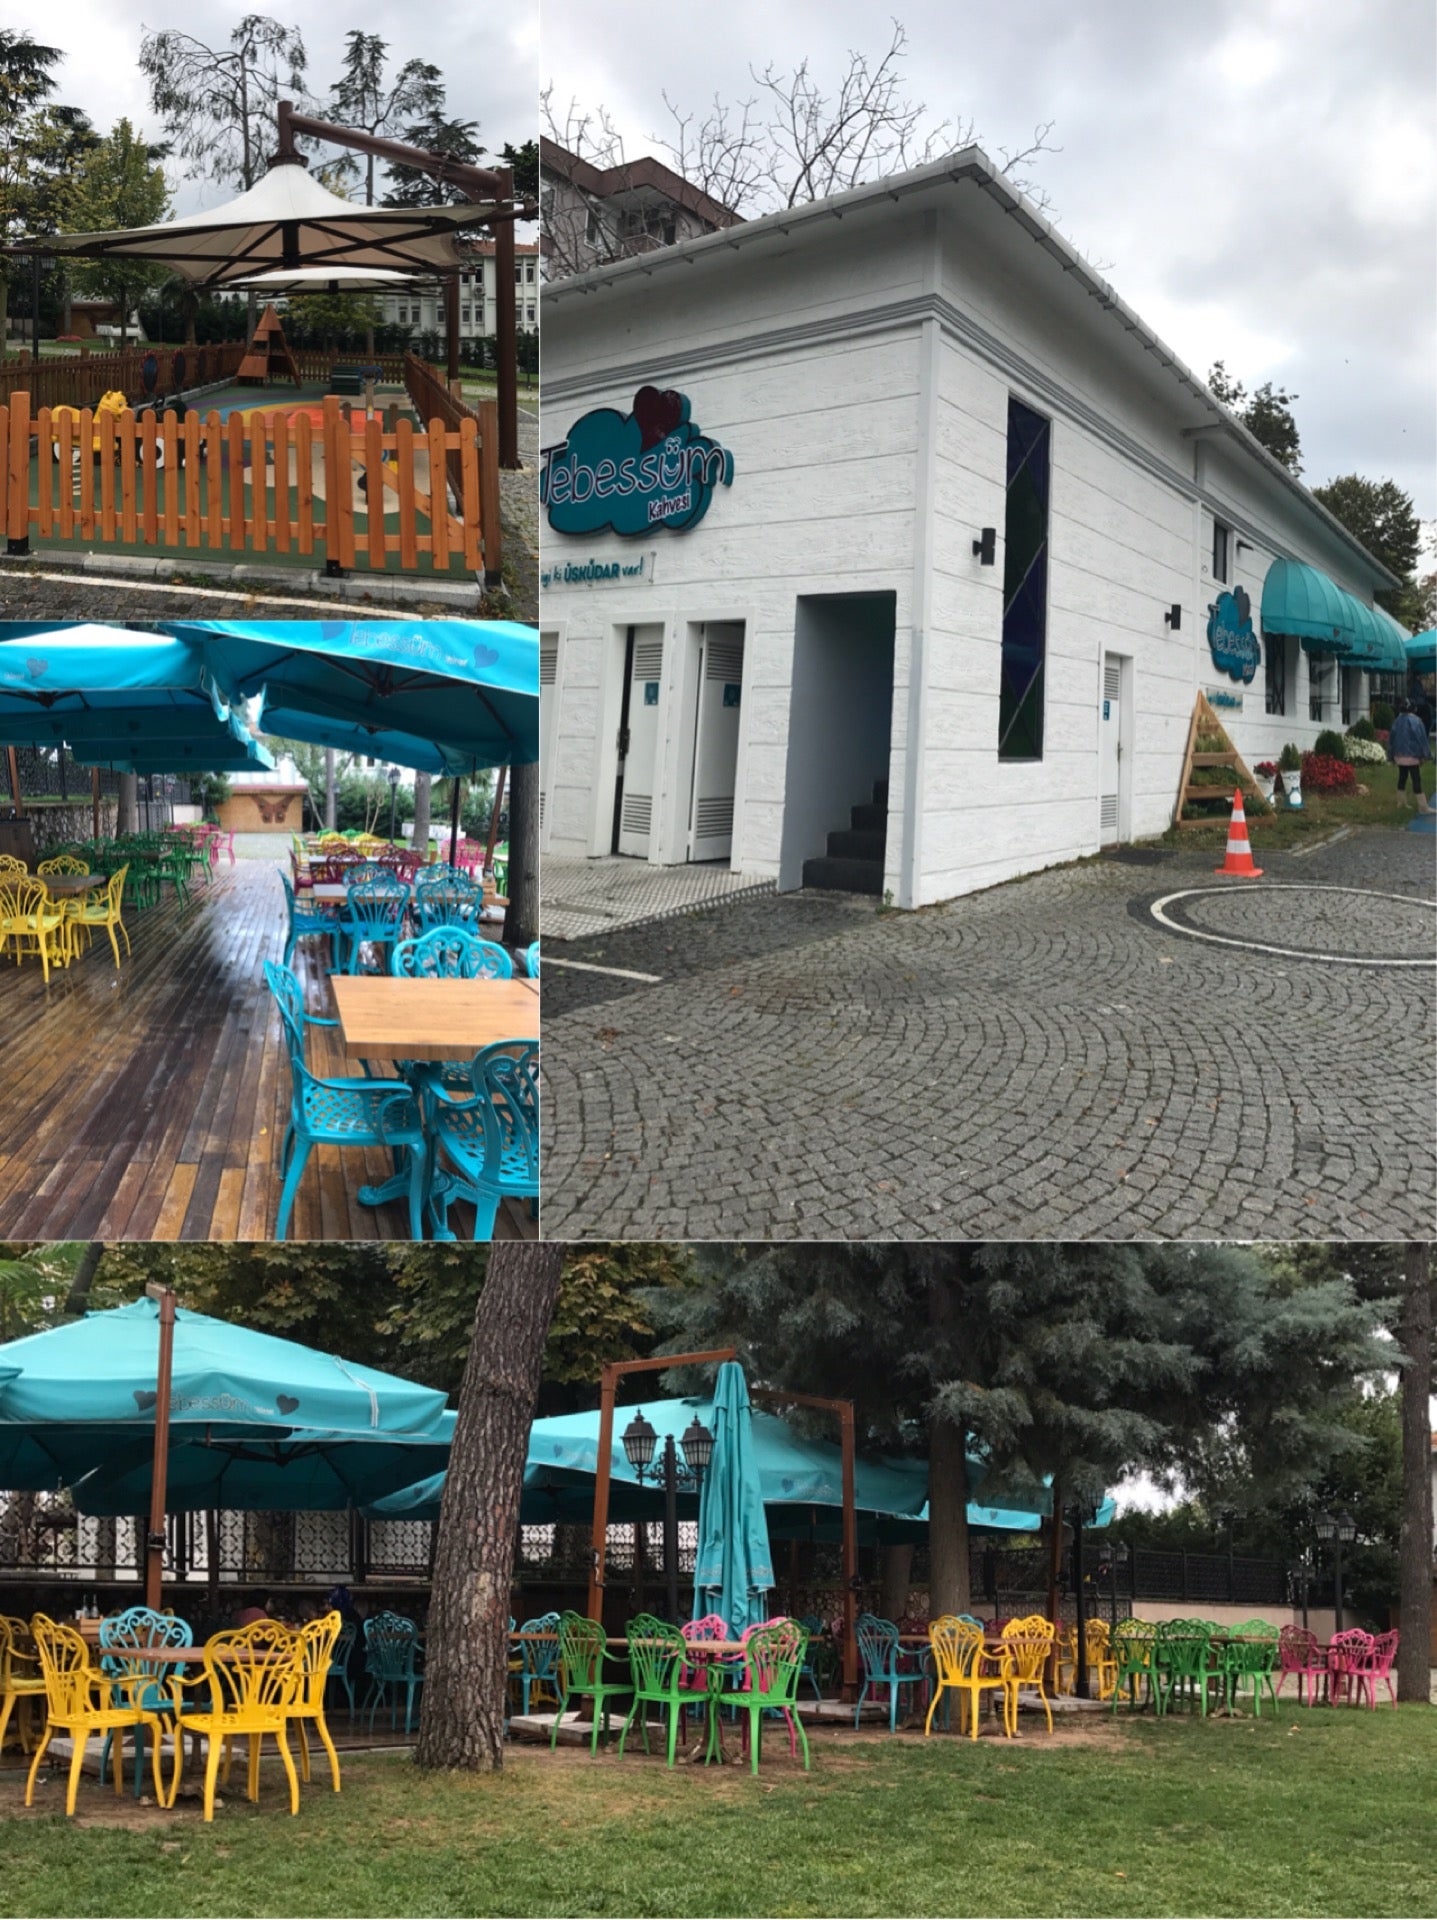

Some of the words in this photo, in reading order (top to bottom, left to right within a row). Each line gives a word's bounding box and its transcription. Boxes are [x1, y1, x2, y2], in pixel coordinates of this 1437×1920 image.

[540, 436, 726, 505] Tebessüm
[648, 489, 691, 521] Kahvesi
[564, 558, 620, 583] ÜSKÜDAR
[622, 555, 644, 577] var!
